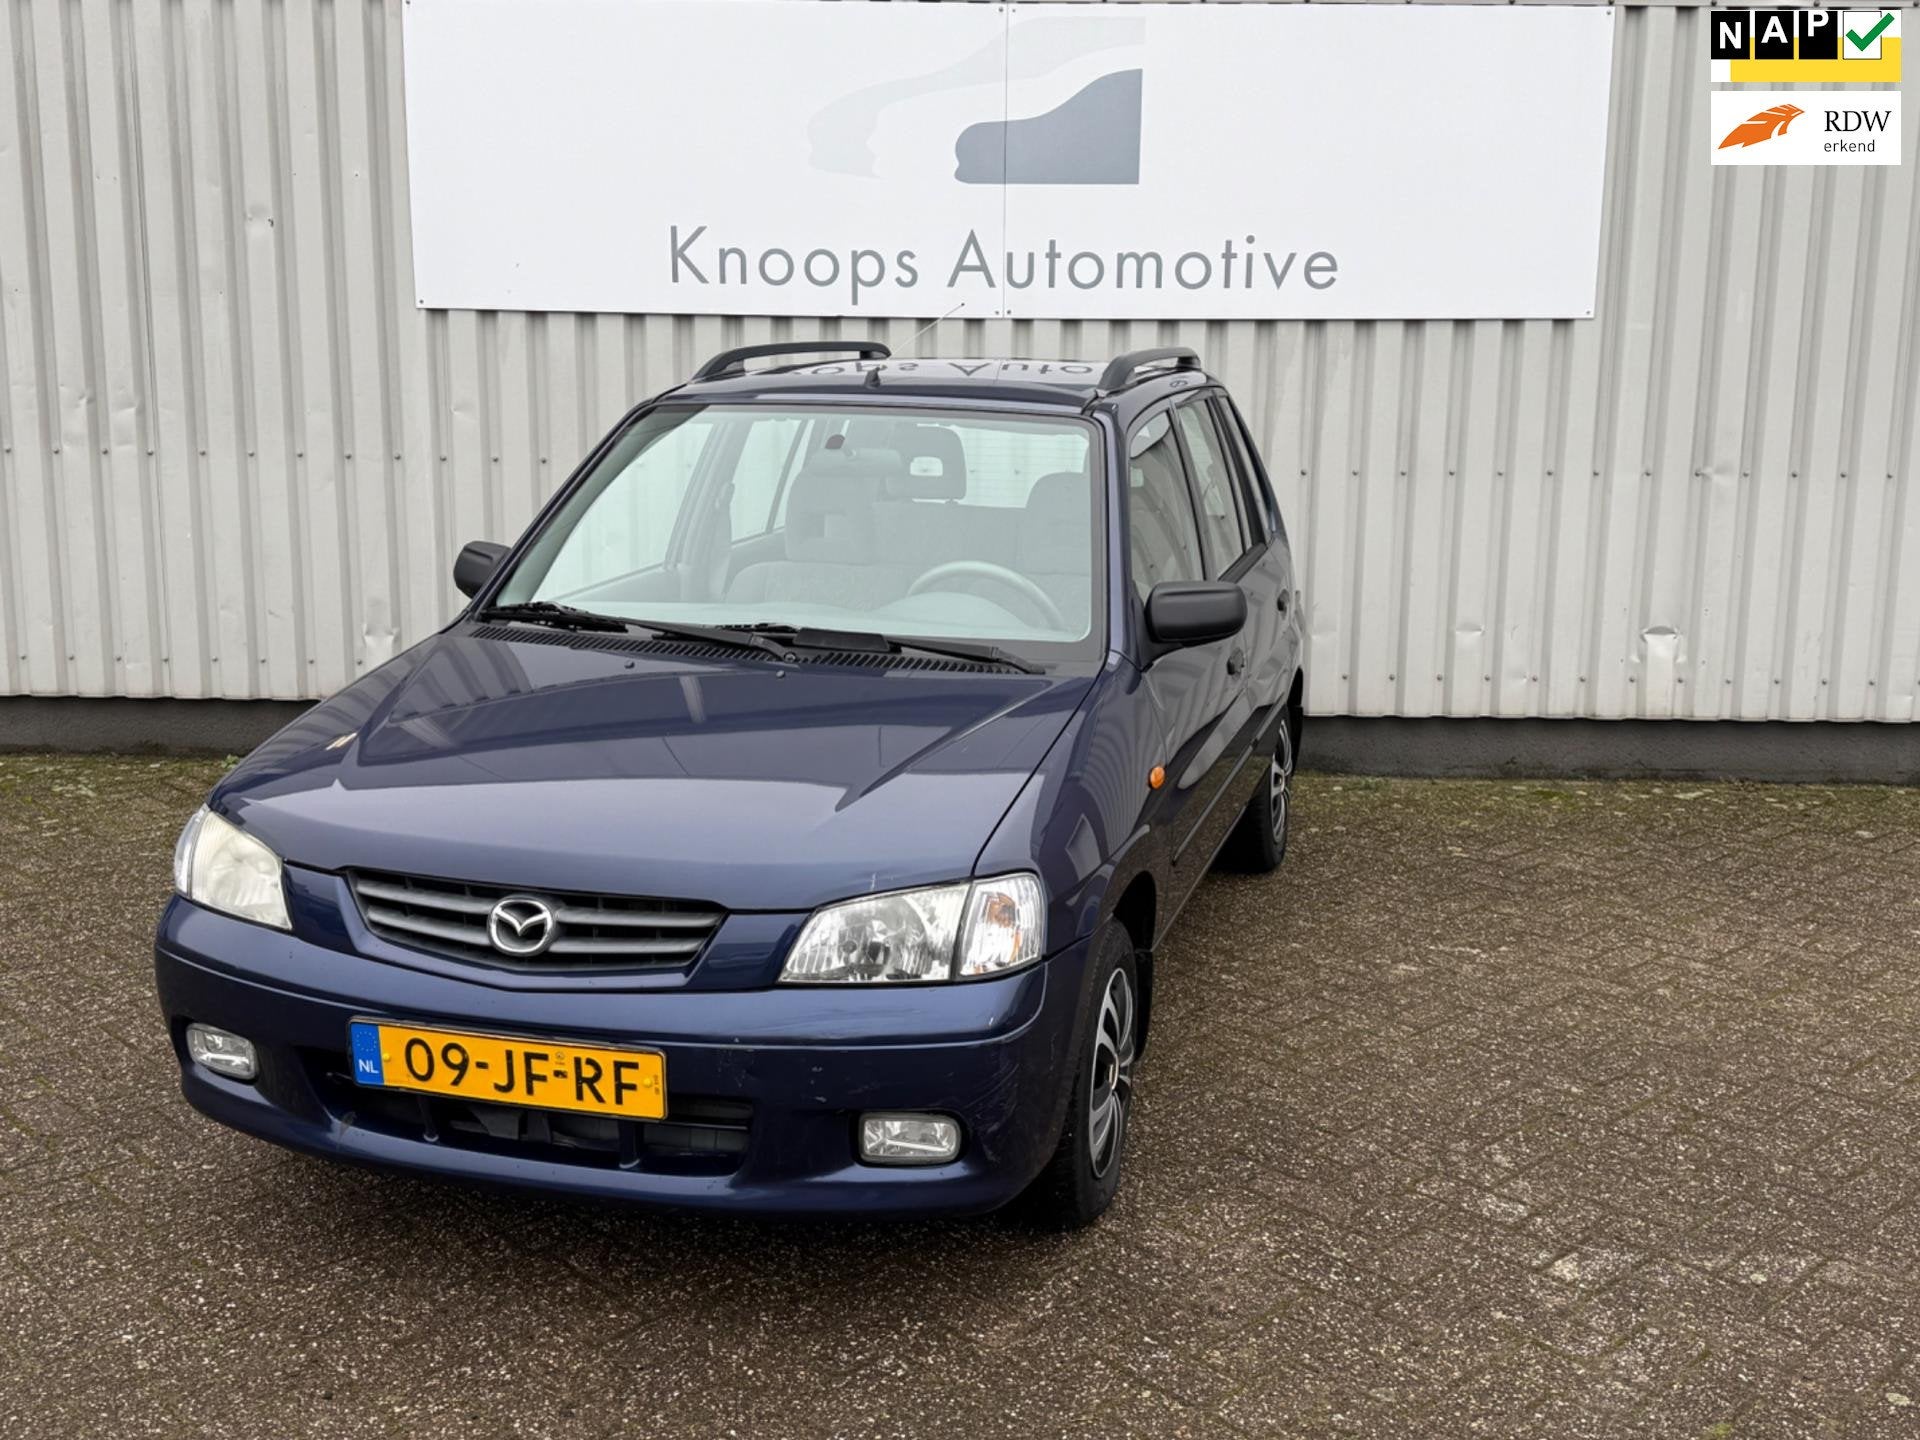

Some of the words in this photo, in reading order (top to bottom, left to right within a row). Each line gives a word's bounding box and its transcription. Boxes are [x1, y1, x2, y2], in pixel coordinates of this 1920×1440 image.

[670, 225, 918, 306] Knoops
[947, 229, 1338, 290] Automotive
[359, 1059, 379, 1074] NL
[404, 1037, 640, 1106] 09-JF-RF
